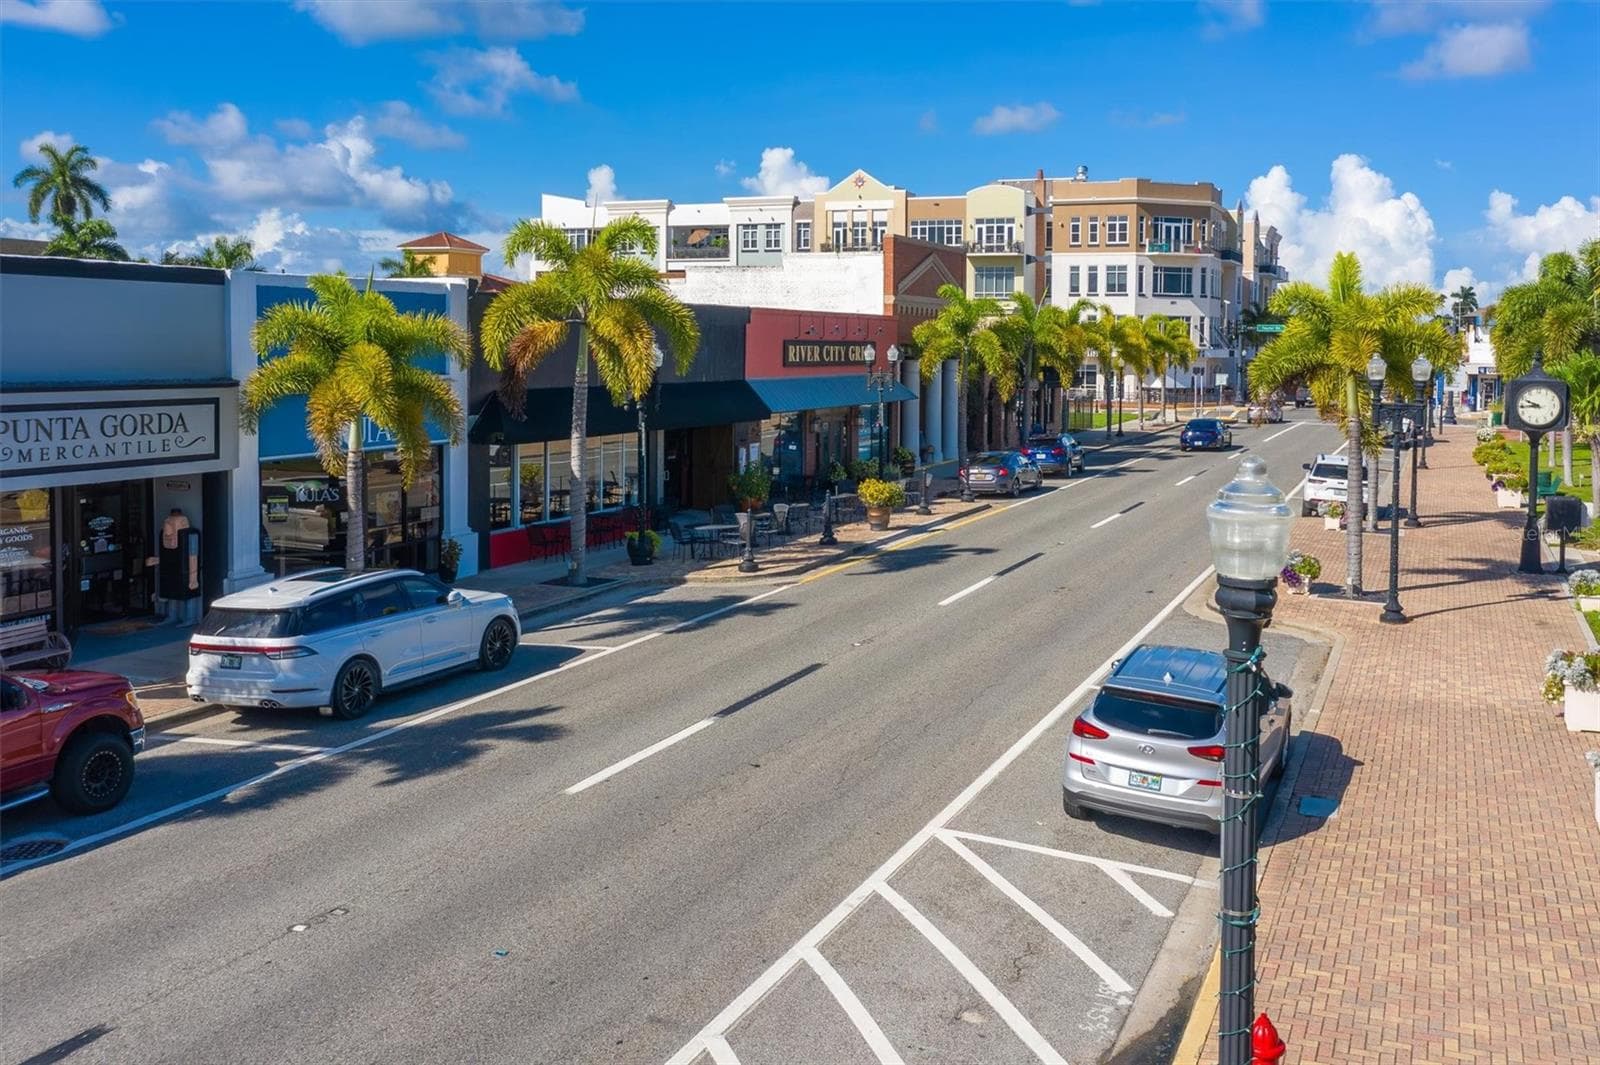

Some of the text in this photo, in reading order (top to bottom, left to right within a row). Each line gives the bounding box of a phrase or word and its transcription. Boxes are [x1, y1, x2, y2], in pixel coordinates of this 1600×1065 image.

[788, 345, 868, 362] RIVER CITY GRI
[0, 413, 189, 444] PUNTA GORDA
[17, 439, 171, 463] MERCANTILE
[5, 533, 33, 543] GOODS
